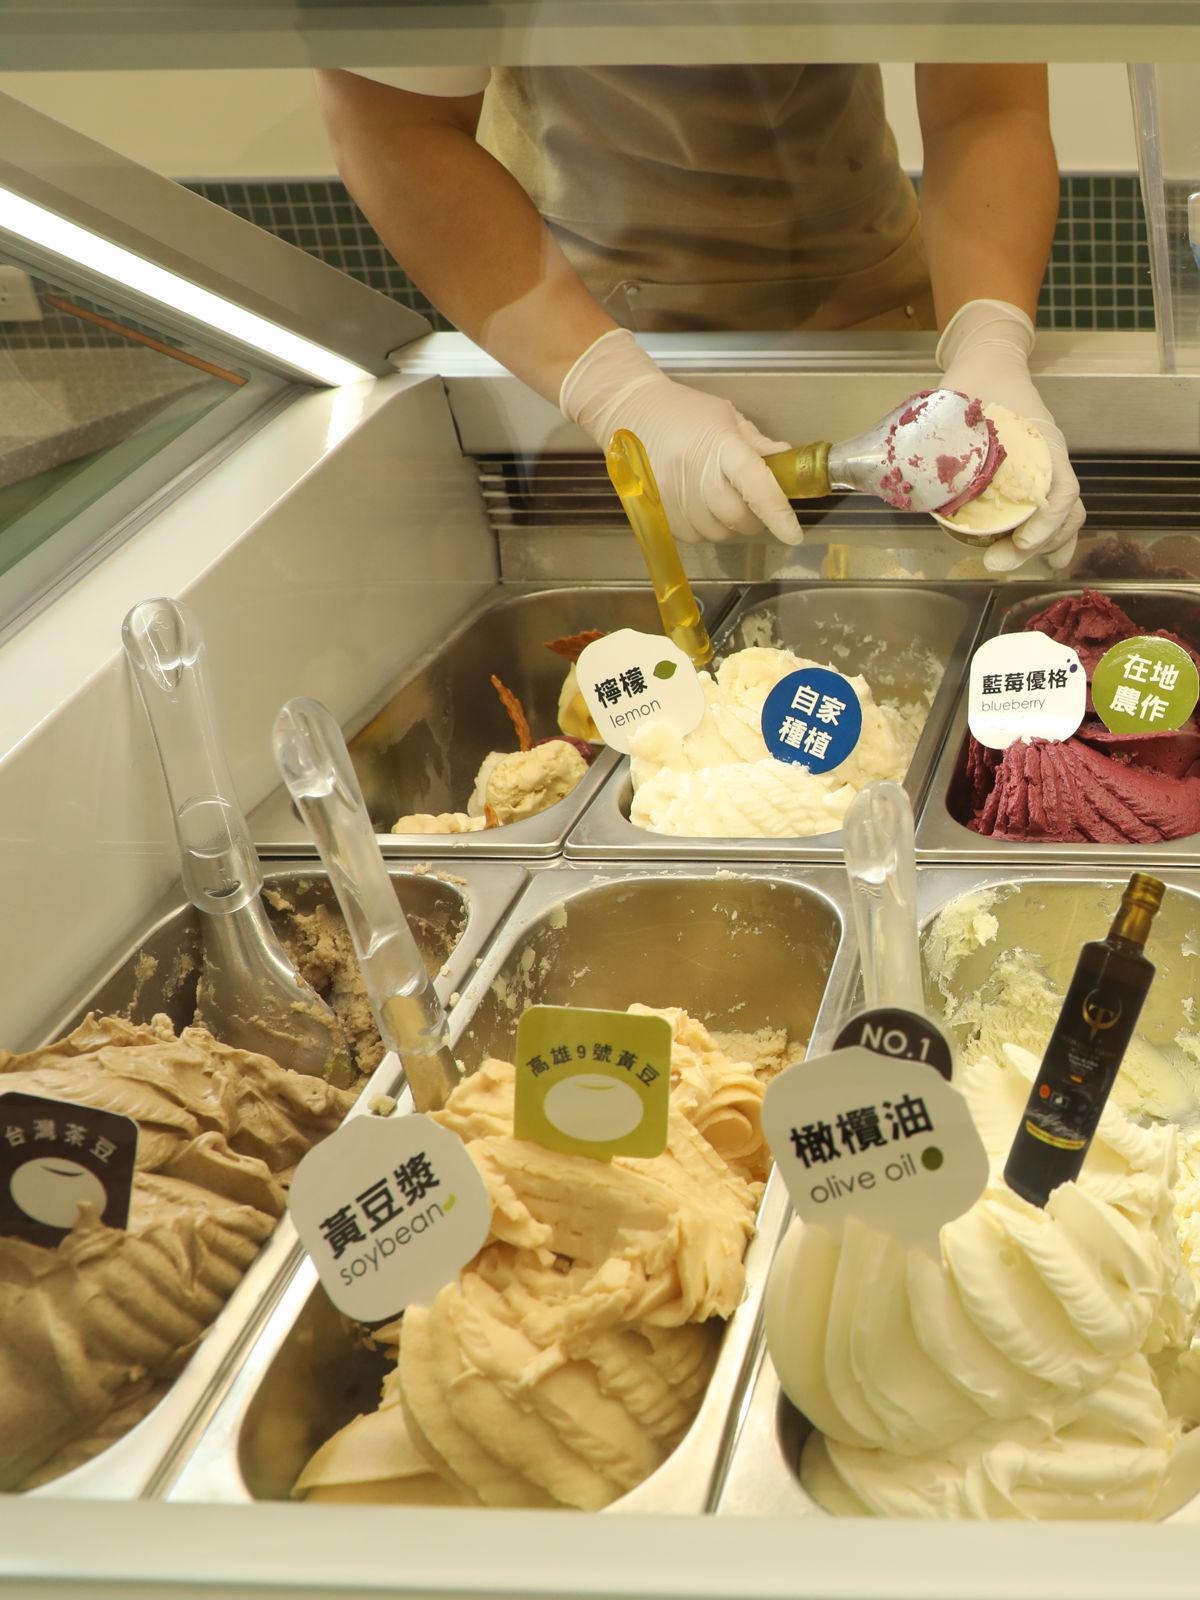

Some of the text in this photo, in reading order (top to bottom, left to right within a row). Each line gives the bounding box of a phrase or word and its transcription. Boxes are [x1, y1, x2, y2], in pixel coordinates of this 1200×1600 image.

[594, 666, 648, 709] 檸檬
[981, 669, 1068, 695] 藍莓優格
[1122, 653, 1180, 692] 在地
[609, 697, 662, 728] lemon
[789, 684, 847, 727] 自家
[981, 697, 1046, 712] blueberry
[1109, 685, 1169, 723] 農作
[777, 714, 833, 760] 種植
[860, 1022, 931, 1062] NO.1
[526, 1043, 660, 1087] 高雄9號黃豆
[4, 1119, 117, 1163] 台灣茶豆
[790, 1093, 935, 1169] 橄欖油
[810, 1148, 918, 1204] olive oil
[318, 1150, 441, 1260] 黃豆漿
[339, 1203, 444, 1286] soybean
